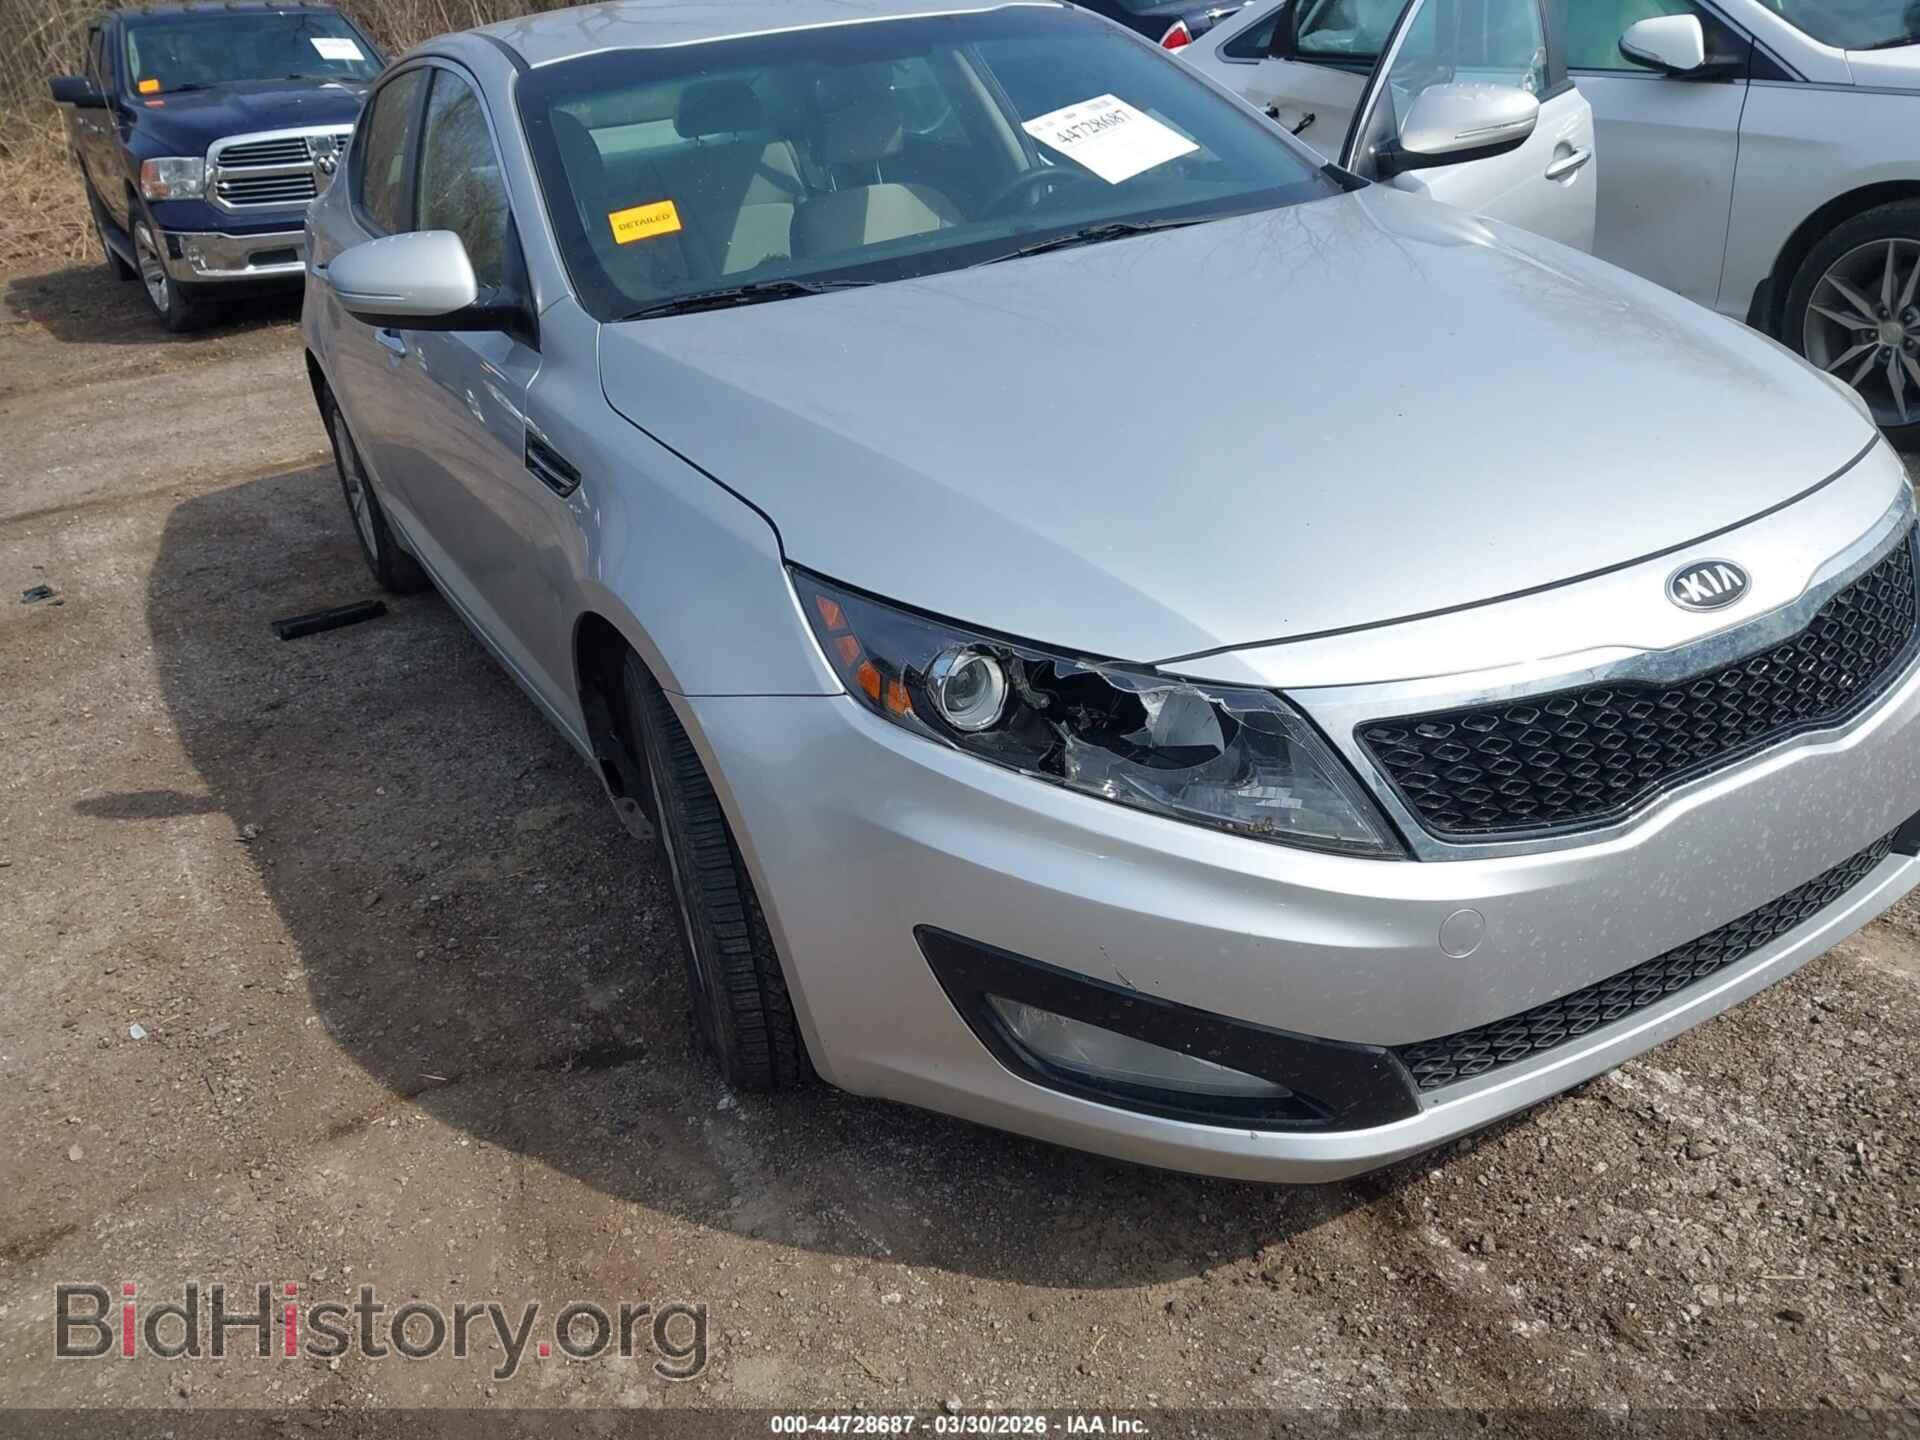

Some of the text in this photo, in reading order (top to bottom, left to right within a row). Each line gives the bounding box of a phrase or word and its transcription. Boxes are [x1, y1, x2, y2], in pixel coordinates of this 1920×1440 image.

[1056, 109, 1132, 143] 44728687
[618, 213, 670, 231] DETAILED
[1677, 564, 1743, 602] KIA
